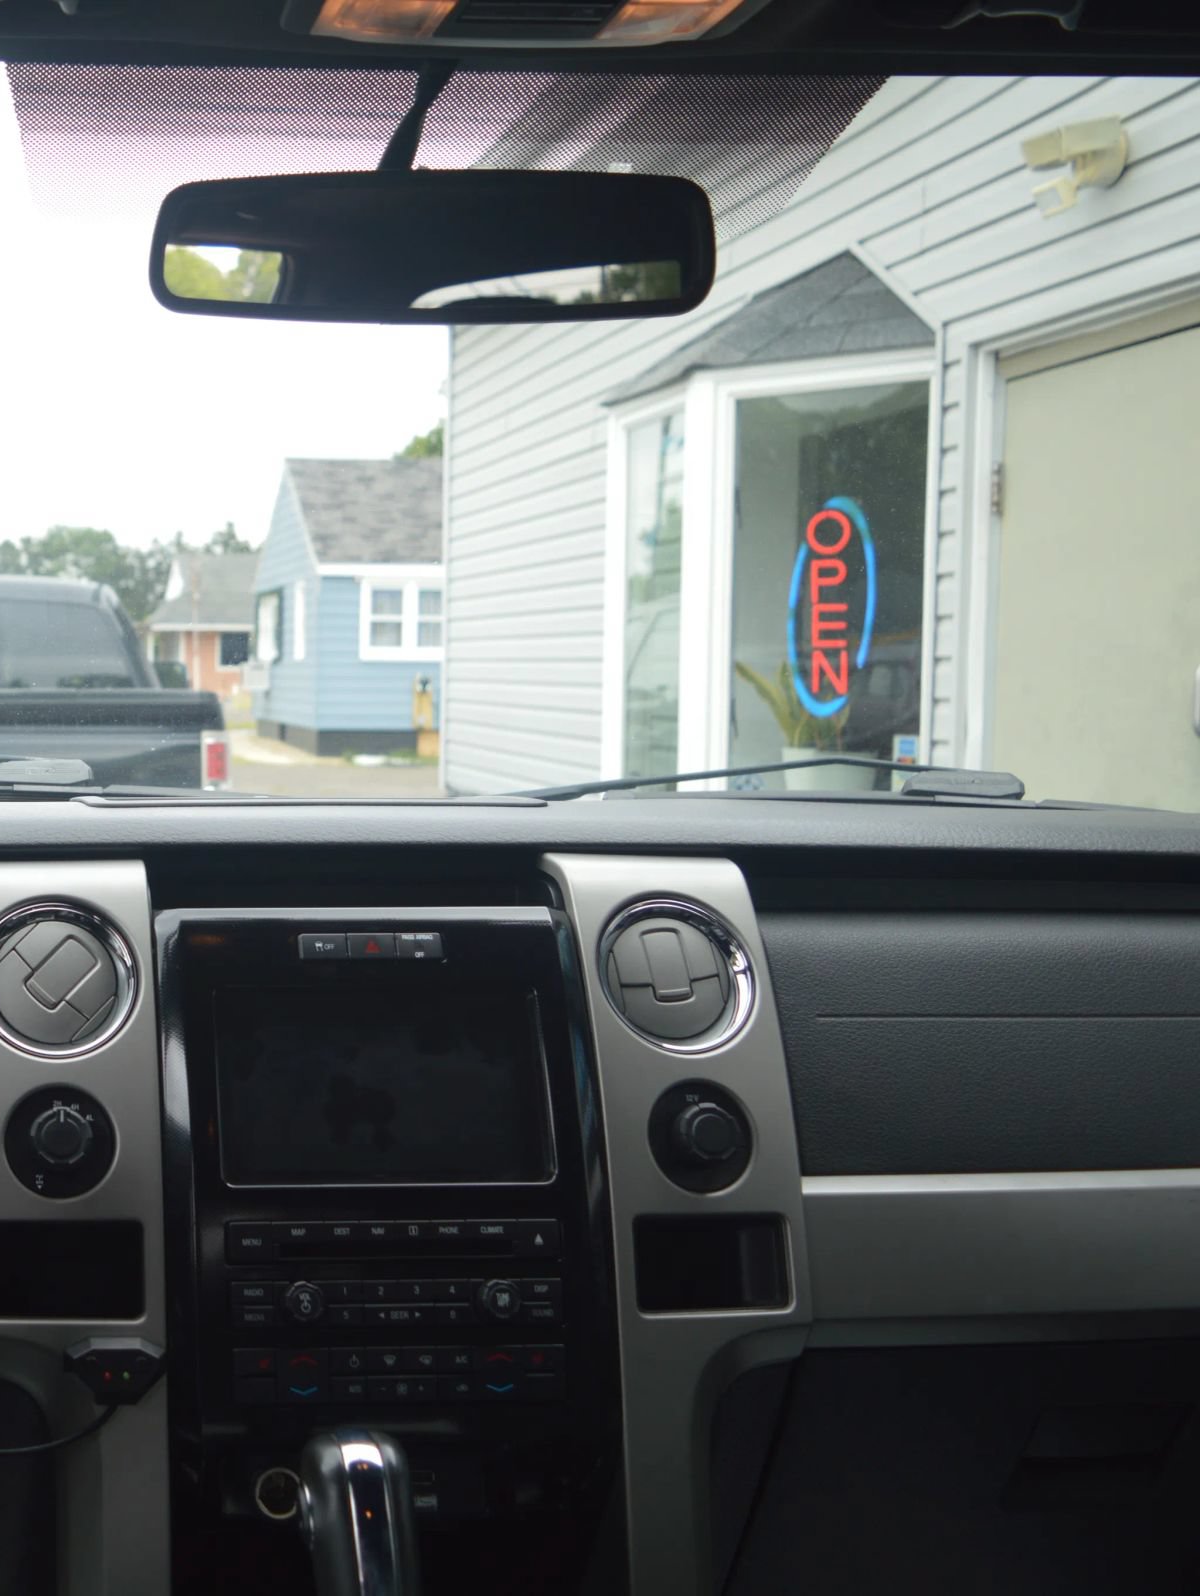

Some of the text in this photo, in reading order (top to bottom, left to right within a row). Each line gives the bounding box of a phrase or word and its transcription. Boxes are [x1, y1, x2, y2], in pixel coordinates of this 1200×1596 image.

[806, 508, 851, 696] OPEN
[323, 943, 335, 951] OFF
[414, 951, 425, 959] OFF
[290, 1227, 306, 1236] MAP
[333, 1226, 351, 1236] DEST
[438, 1226, 459, 1234] PHONE
[480, 1225, 504, 1234] CLIMATE
[241, 1237, 262, 1247] MENU
[243, 1288, 264, 1297] RADIO
[377, 1286, 385, 1296] 2
[413, 1285, 421, 1295] 3
[449, 1284, 456, 1295] 4
[343, 1311, 350, 1320] 5
